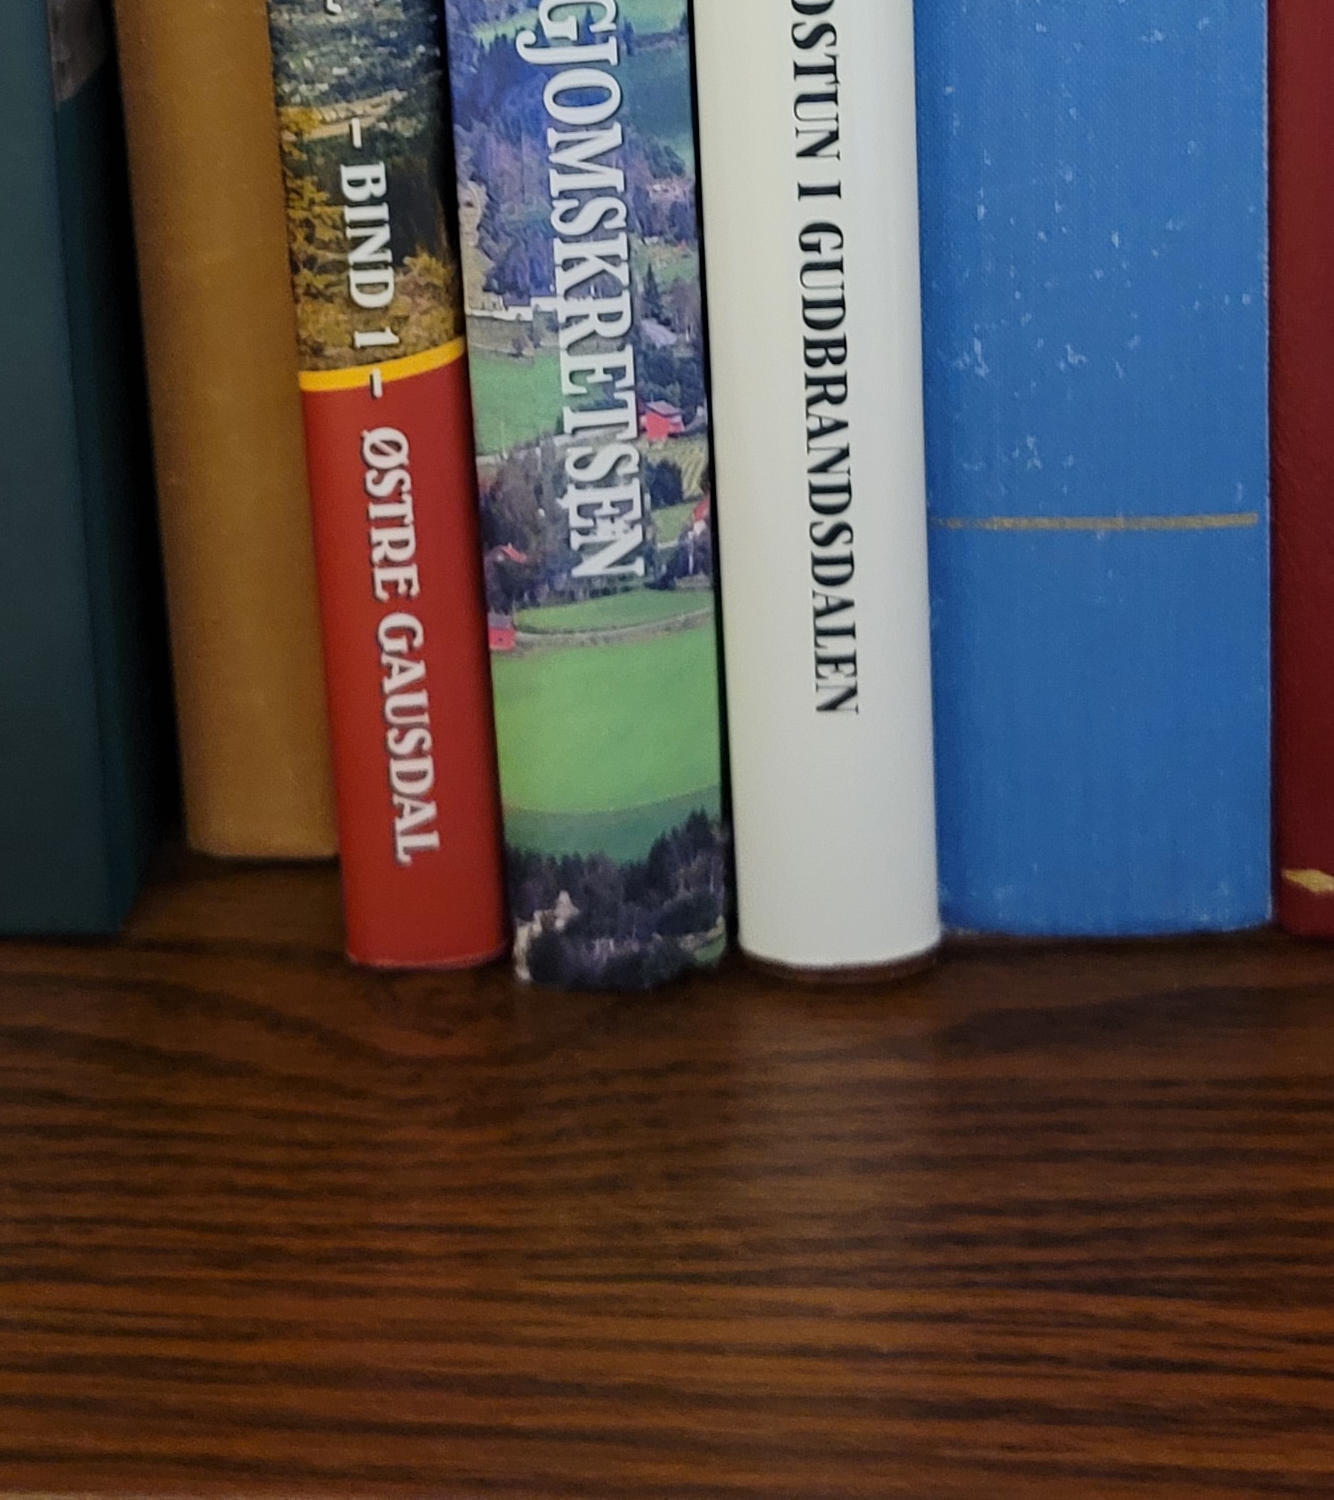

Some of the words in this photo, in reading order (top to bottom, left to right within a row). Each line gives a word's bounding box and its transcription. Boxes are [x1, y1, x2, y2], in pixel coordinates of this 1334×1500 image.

[339, 162, 395, 309] BIND
[797, 180, 843, 202] I
[353, 327, 400, 349] 1
[360, 425, 421, 602] ØSTRE
[798, 221, 860, 715] GUDBRANDSDALEN
[377, 612, 441, 866] GAUSDAL
